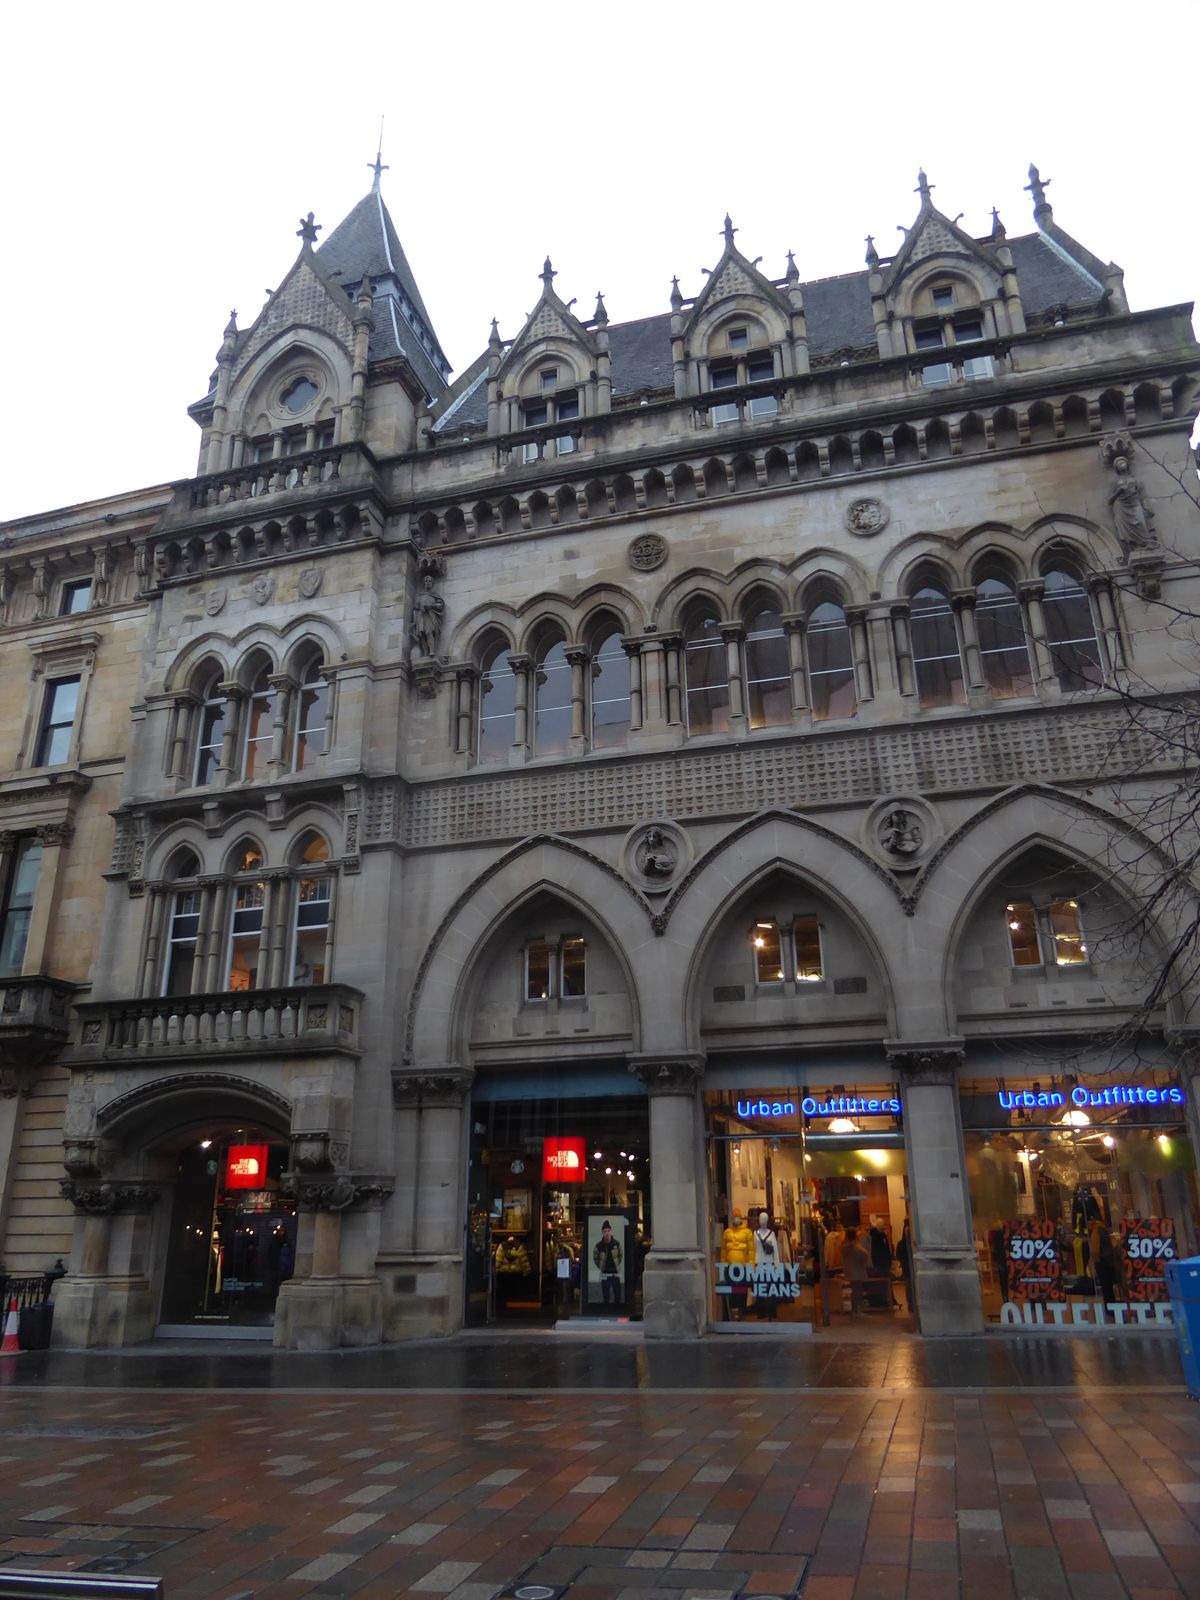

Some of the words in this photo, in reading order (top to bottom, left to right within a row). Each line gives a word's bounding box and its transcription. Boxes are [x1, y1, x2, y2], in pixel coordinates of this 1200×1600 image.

[736, 1100, 796, 1117] Urban
[801, 1097, 901, 1115] Outfitters
[998, 1090, 1065, 1109] Urban
[1071, 1086, 1183, 1105] Outfitters
[1010, 1239, 1055, 1259] 30%
[1127, 1238, 1174, 1258] 30%
[715, 1263, 800, 1281] TOMMY
[752, 1283, 800, 1297] JEANS
